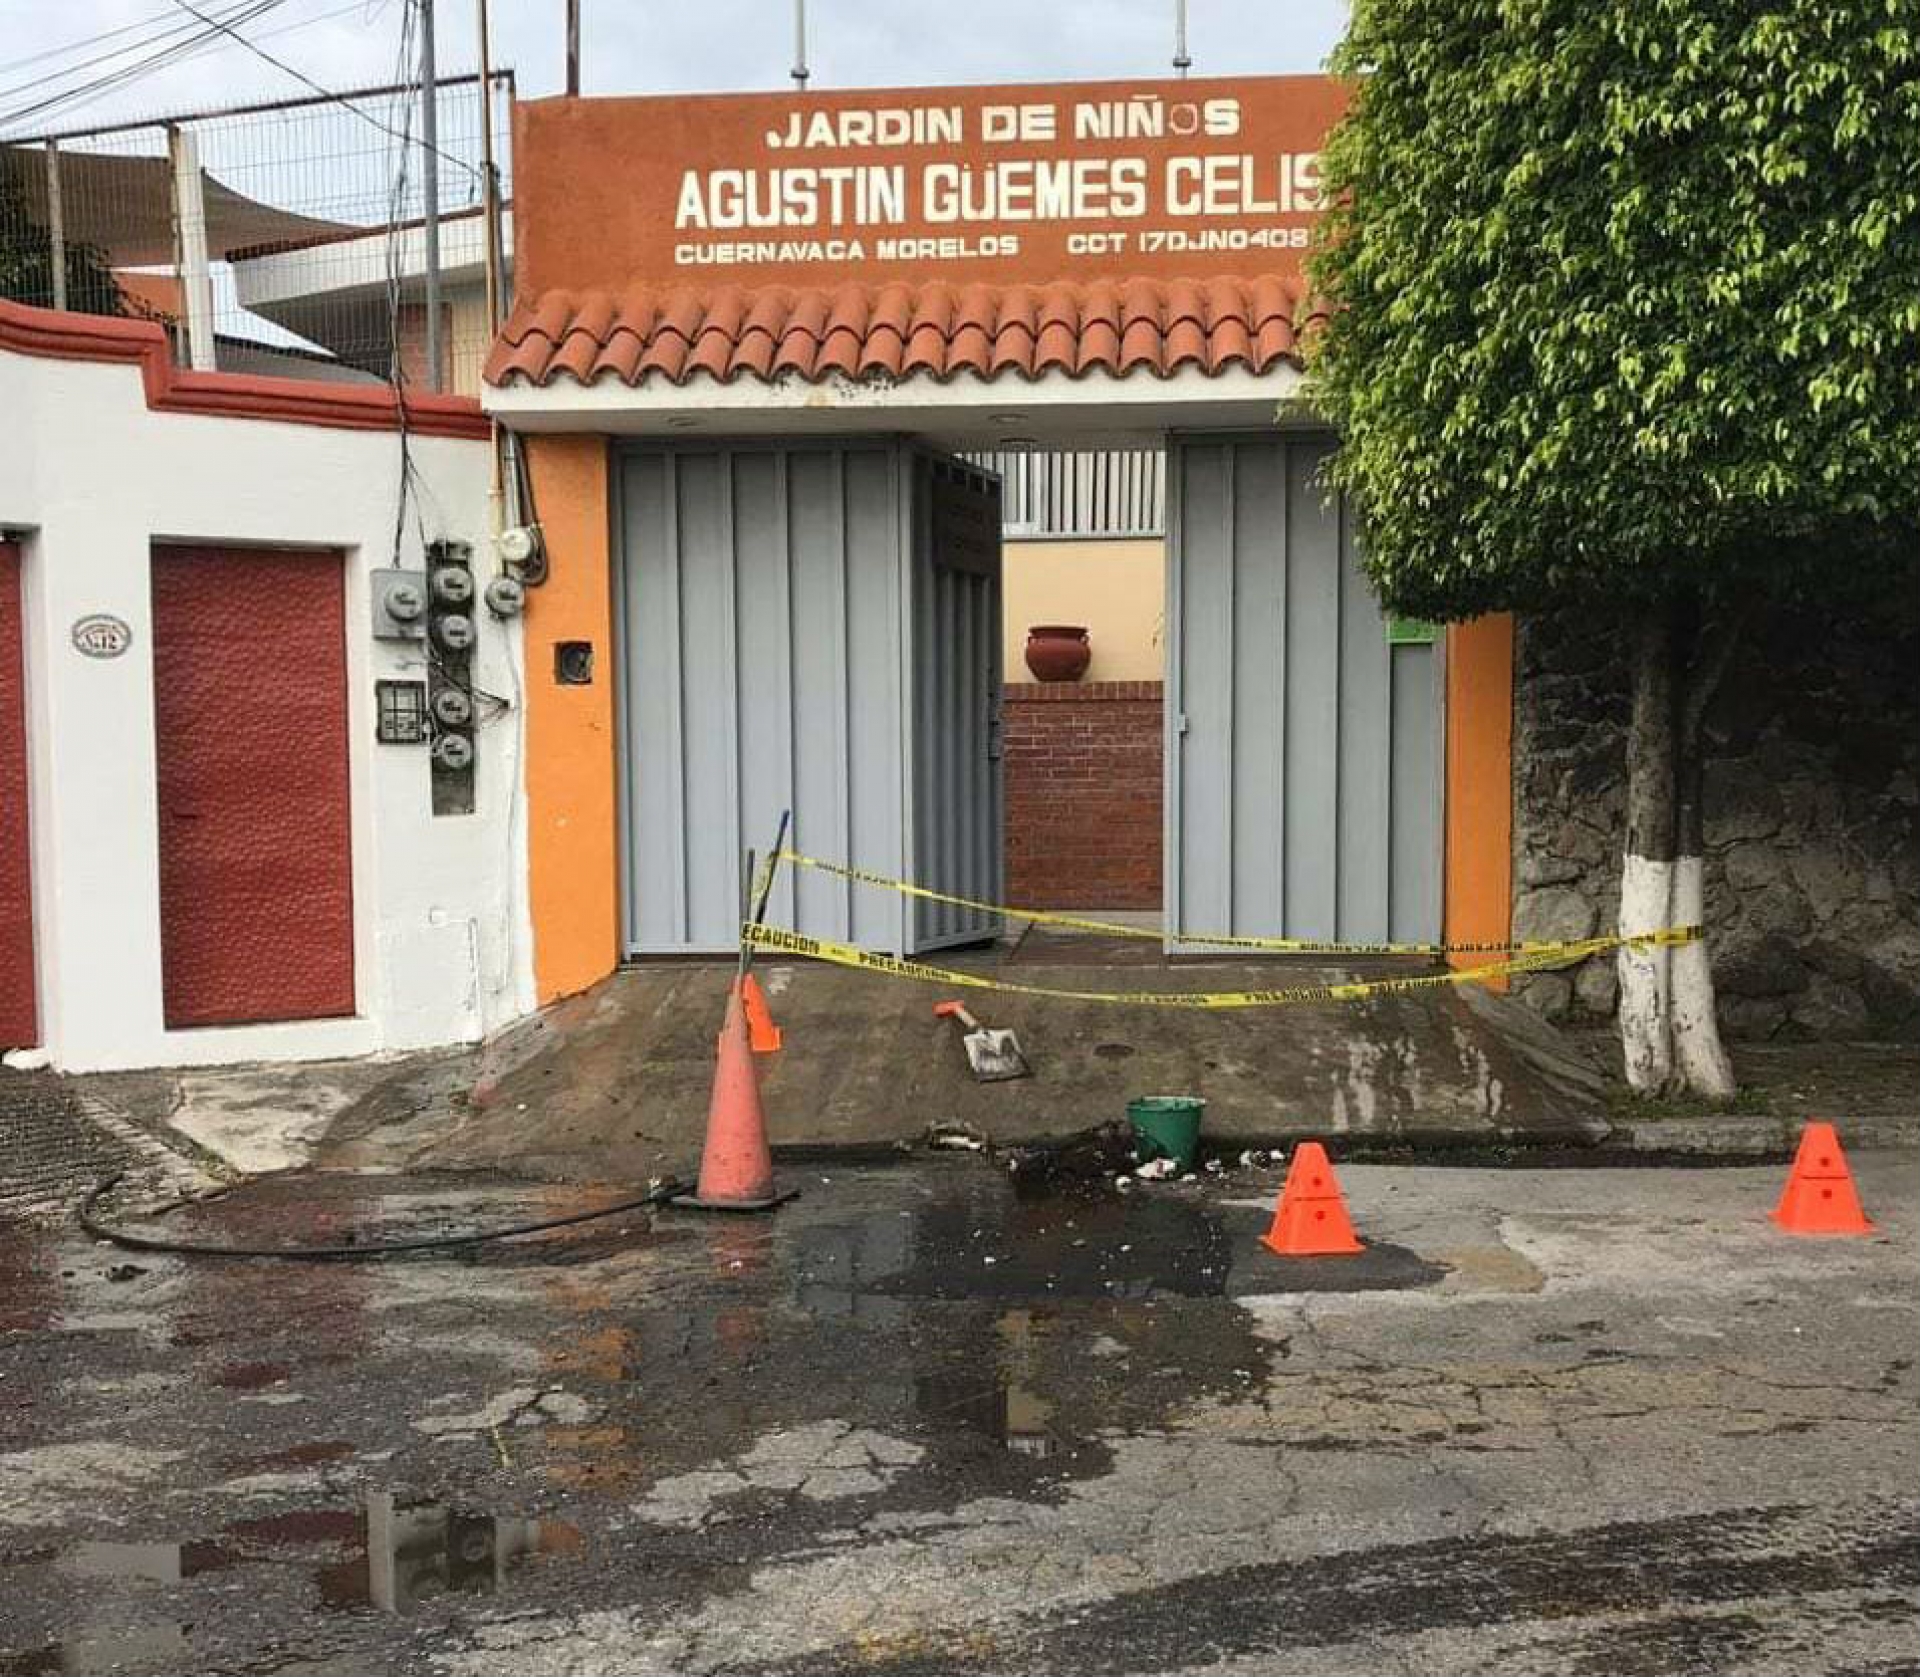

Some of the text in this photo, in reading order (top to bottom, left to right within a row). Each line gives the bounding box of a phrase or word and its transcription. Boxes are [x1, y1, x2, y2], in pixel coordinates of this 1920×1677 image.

[766, 94, 1240, 148] JARDIN DE NIÑOS
[674, 153, 1330, 230] AGUSTIN GÜEMES CELIS
[674, 239, 864, 265] CUERNAVACA
[876, 235, 1019, 260] MORELOS
[1067, 232, 1127, 254] CCT
